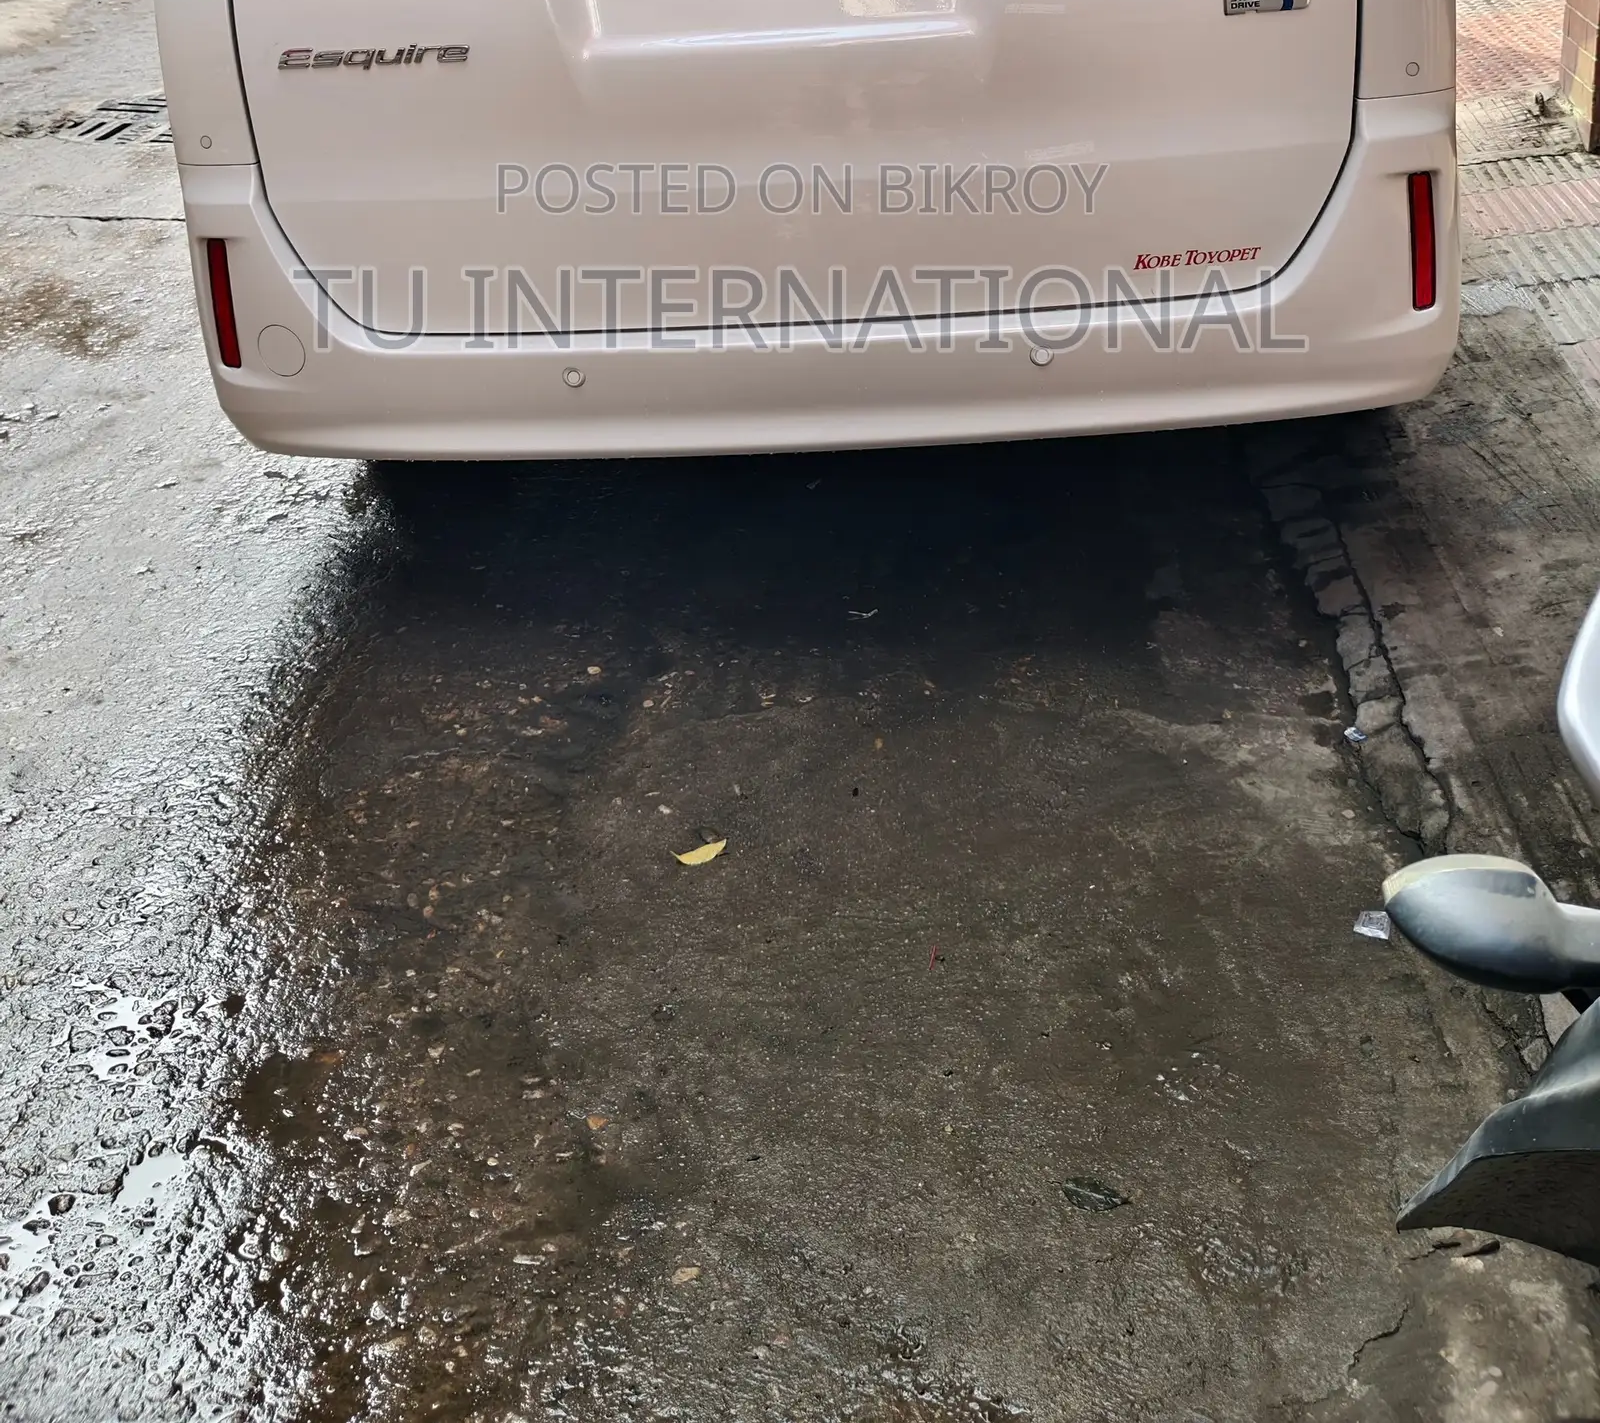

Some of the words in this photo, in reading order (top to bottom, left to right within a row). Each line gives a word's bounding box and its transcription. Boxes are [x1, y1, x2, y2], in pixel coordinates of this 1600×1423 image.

[1230, 1, 1261, 9] DRIVE
[278, 43, 470, 71] Esquire
[1133, 253, 1182, 270] KOBE
[1184, 246, 1261, 266] TOYOPET
